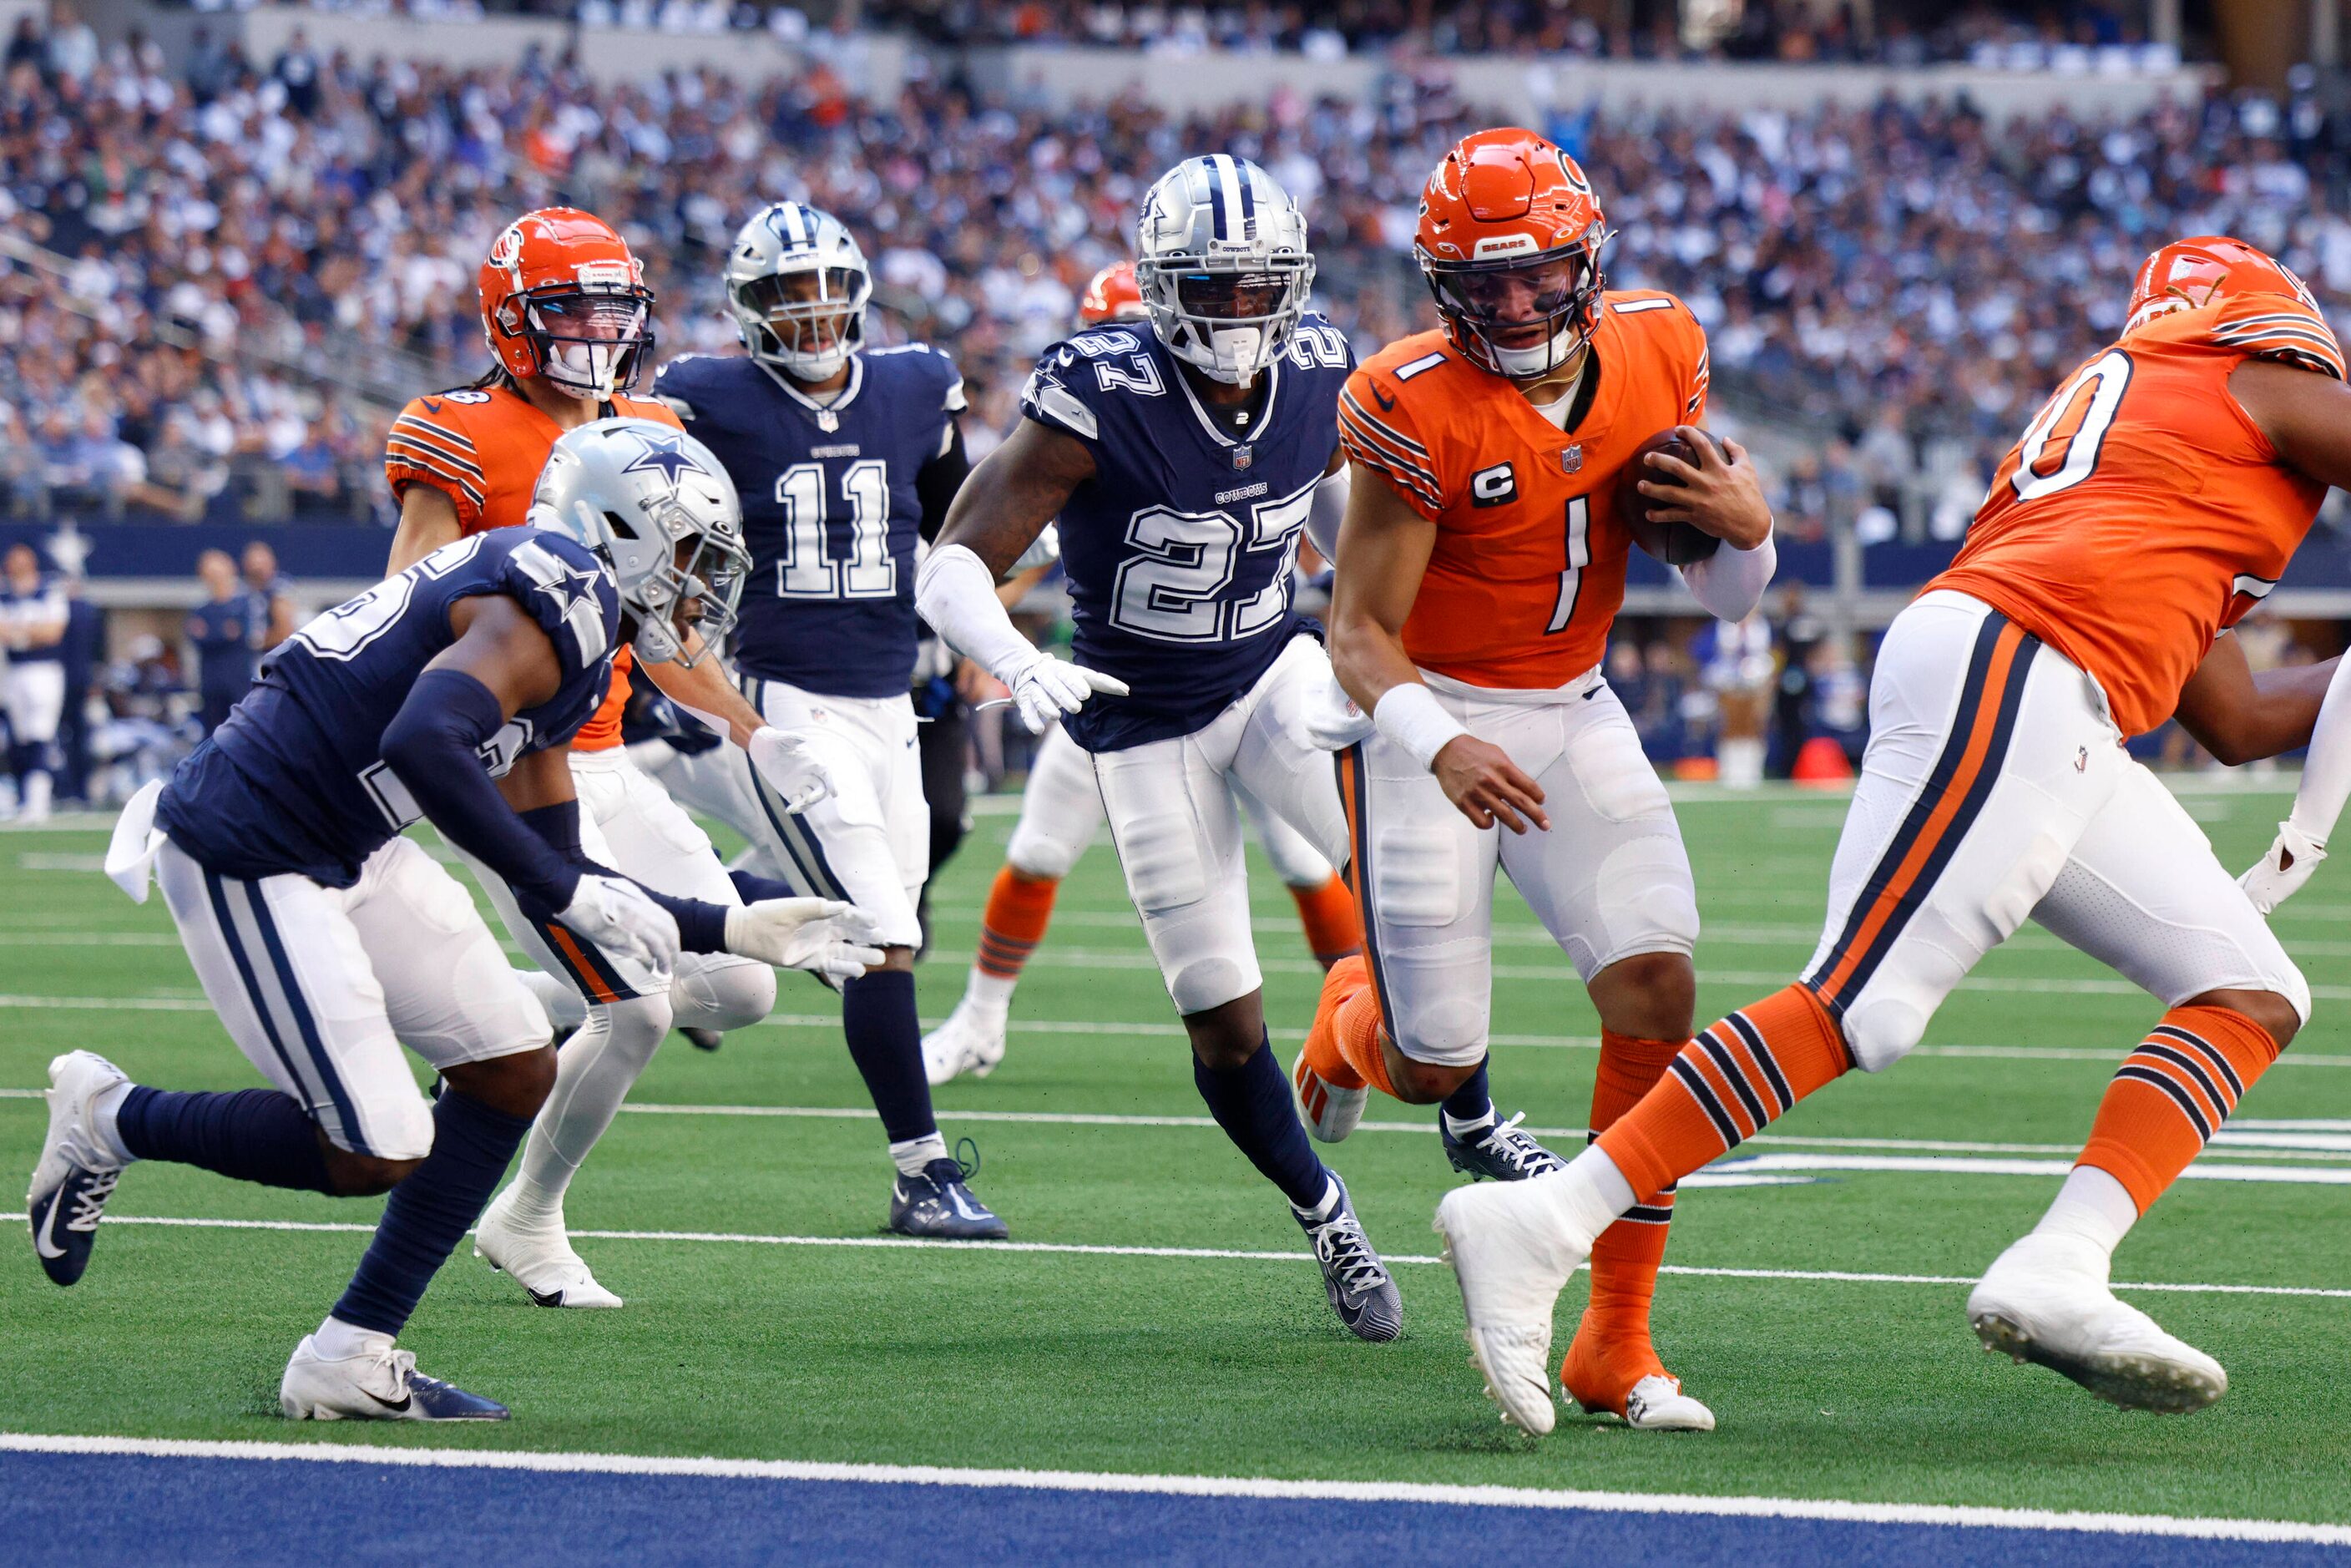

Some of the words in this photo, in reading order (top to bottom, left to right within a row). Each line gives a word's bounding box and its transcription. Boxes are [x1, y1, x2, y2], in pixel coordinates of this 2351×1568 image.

[1482, 240, 1527, 252] BEARS
[1610, 298, 1675, 314] 1
[1288, 310, 1348, 371] 2
[1069, 331, 1167, 397] 27
[1393, 350, 1449, 382] 1
[1236, 412, 1249, 424] 2
[1236, 457, 1250, 467] NFL
[1216, 482, 1268, 504] COWBOYS
[1474, 466, 1514, 499] C
[775, 459, 897, 599] 11
[1109, 470, 1325, 643] 27
[1543, 493, 1592, 635] 1
